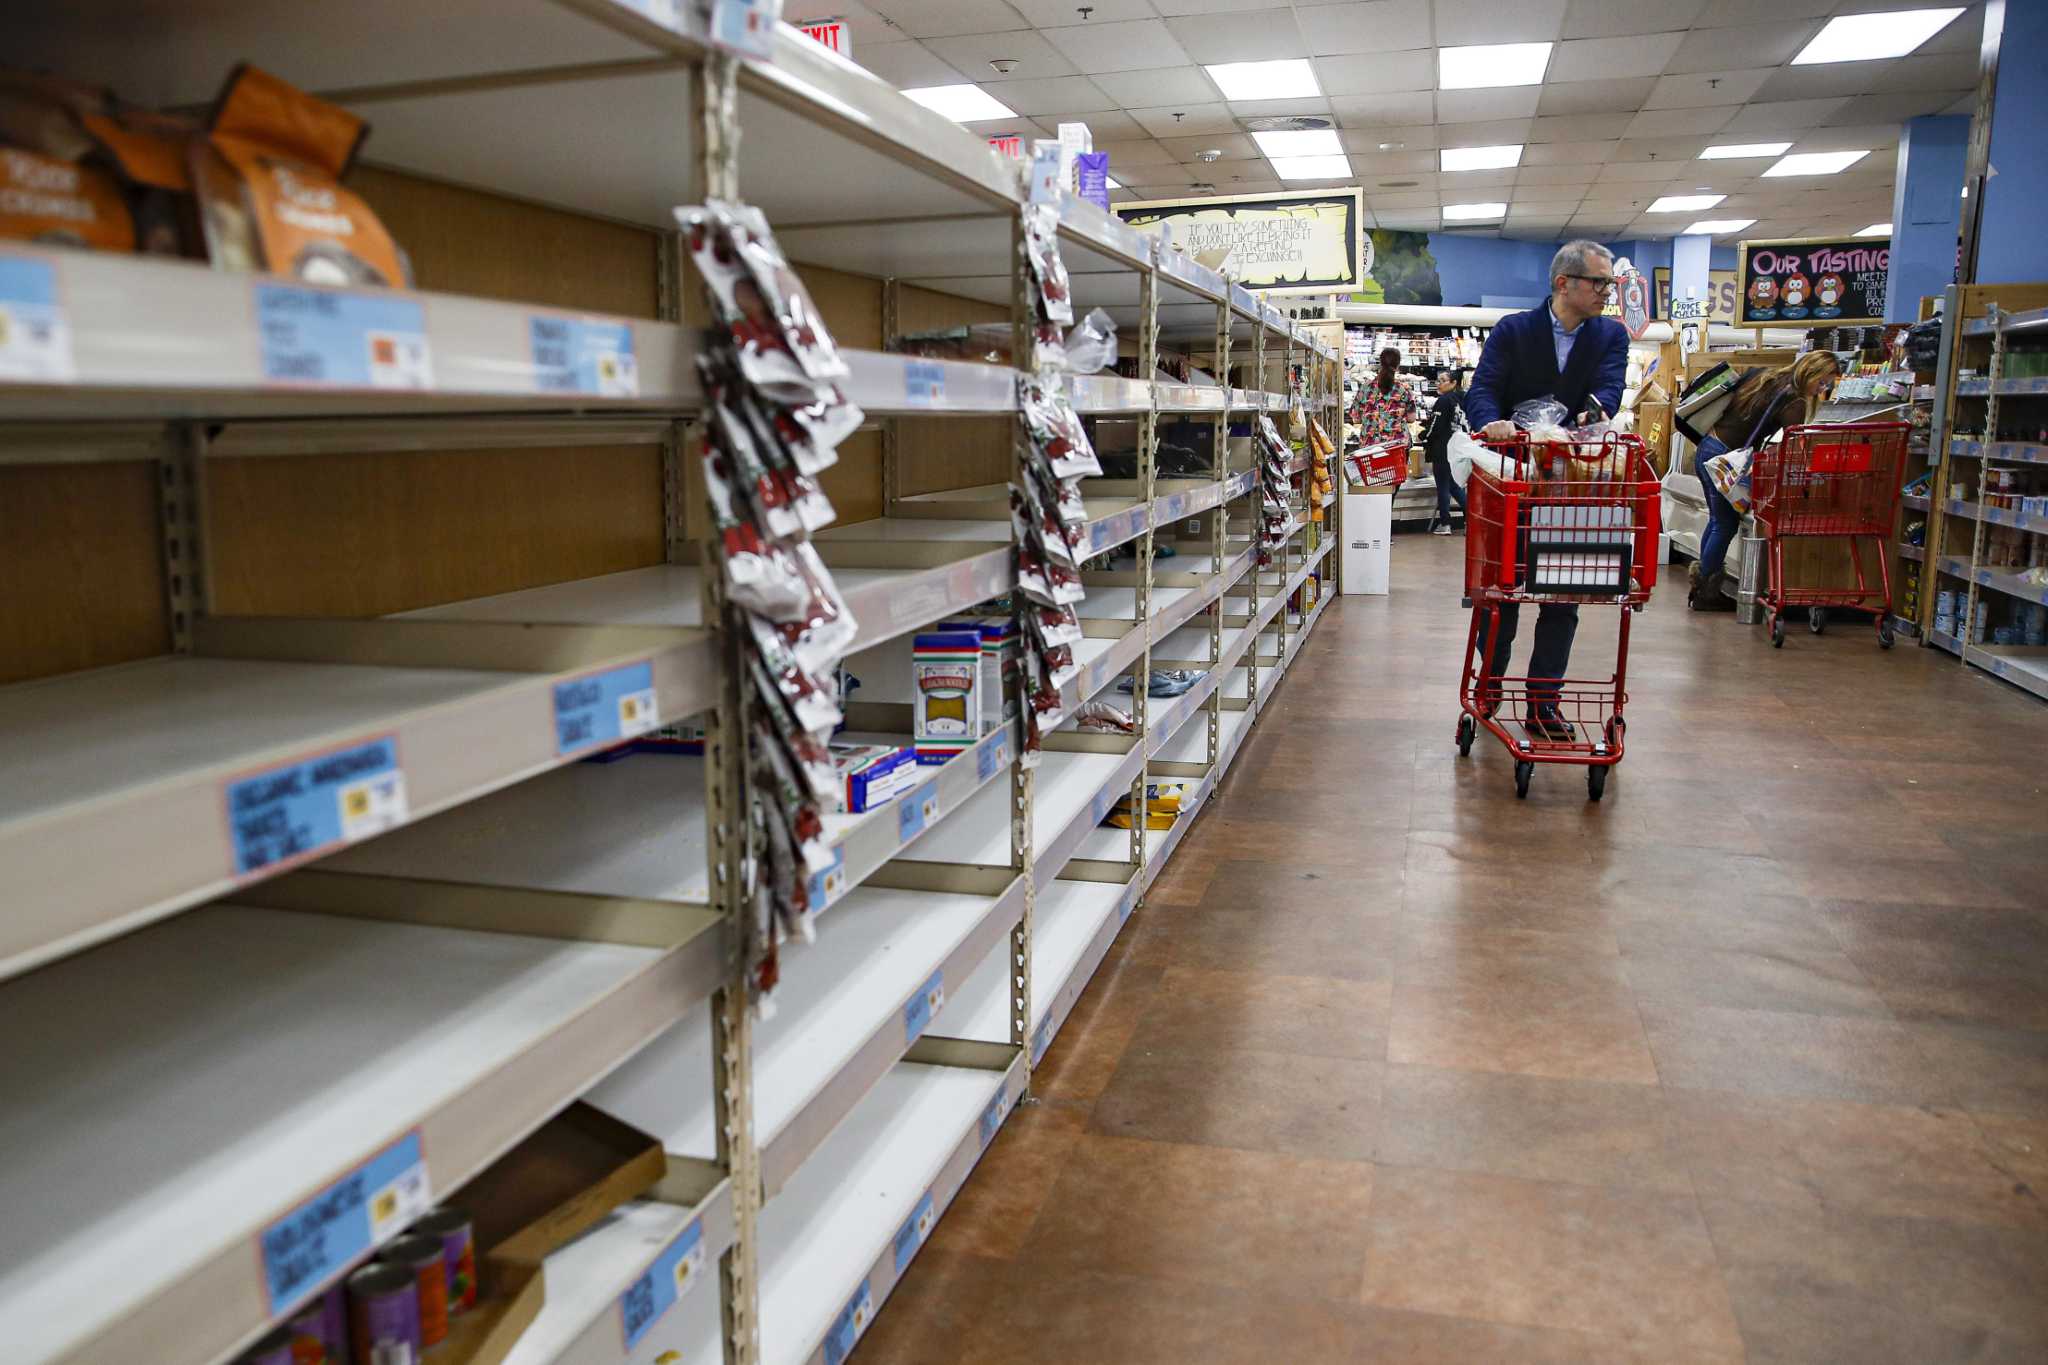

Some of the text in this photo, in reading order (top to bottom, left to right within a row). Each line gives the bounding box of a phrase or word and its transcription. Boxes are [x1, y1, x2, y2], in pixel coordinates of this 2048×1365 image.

[801, 25, 839, 52] XIT
[1205, 222, 1222, 235] YOU
[1226, 221, 1247, 234] TRY
[1808, 247, 1889, 274] TASTING
[1857, 271, 1887, 282] MEETS
[1852, 281, 1864, 292] TO
